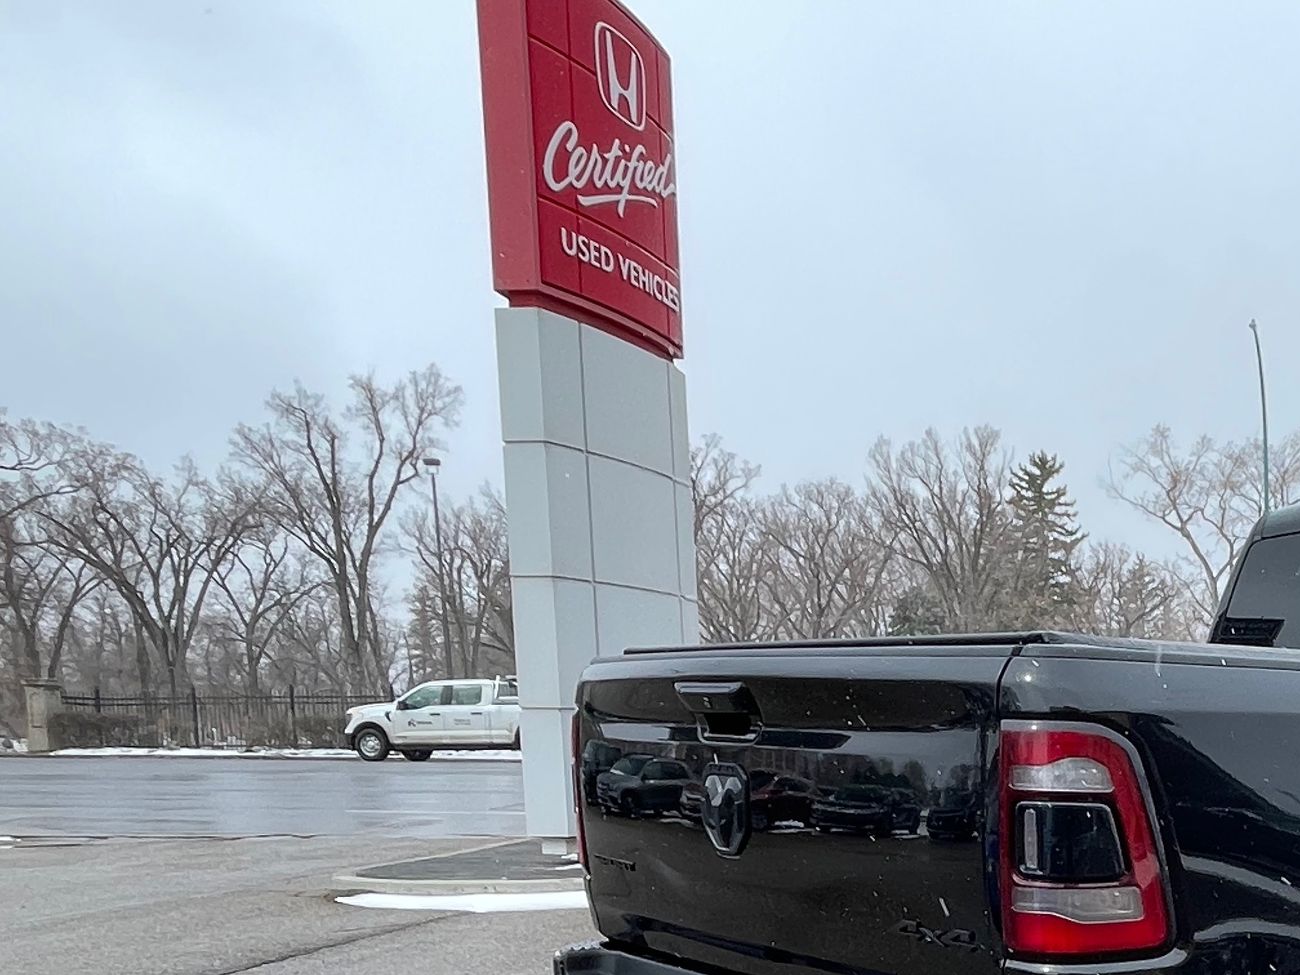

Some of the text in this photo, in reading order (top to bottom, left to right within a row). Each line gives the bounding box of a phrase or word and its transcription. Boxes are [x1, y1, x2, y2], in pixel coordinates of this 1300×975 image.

[543, 120, 677, 218] Certified
[560, 226, 680, 313] USED VEHICLES
